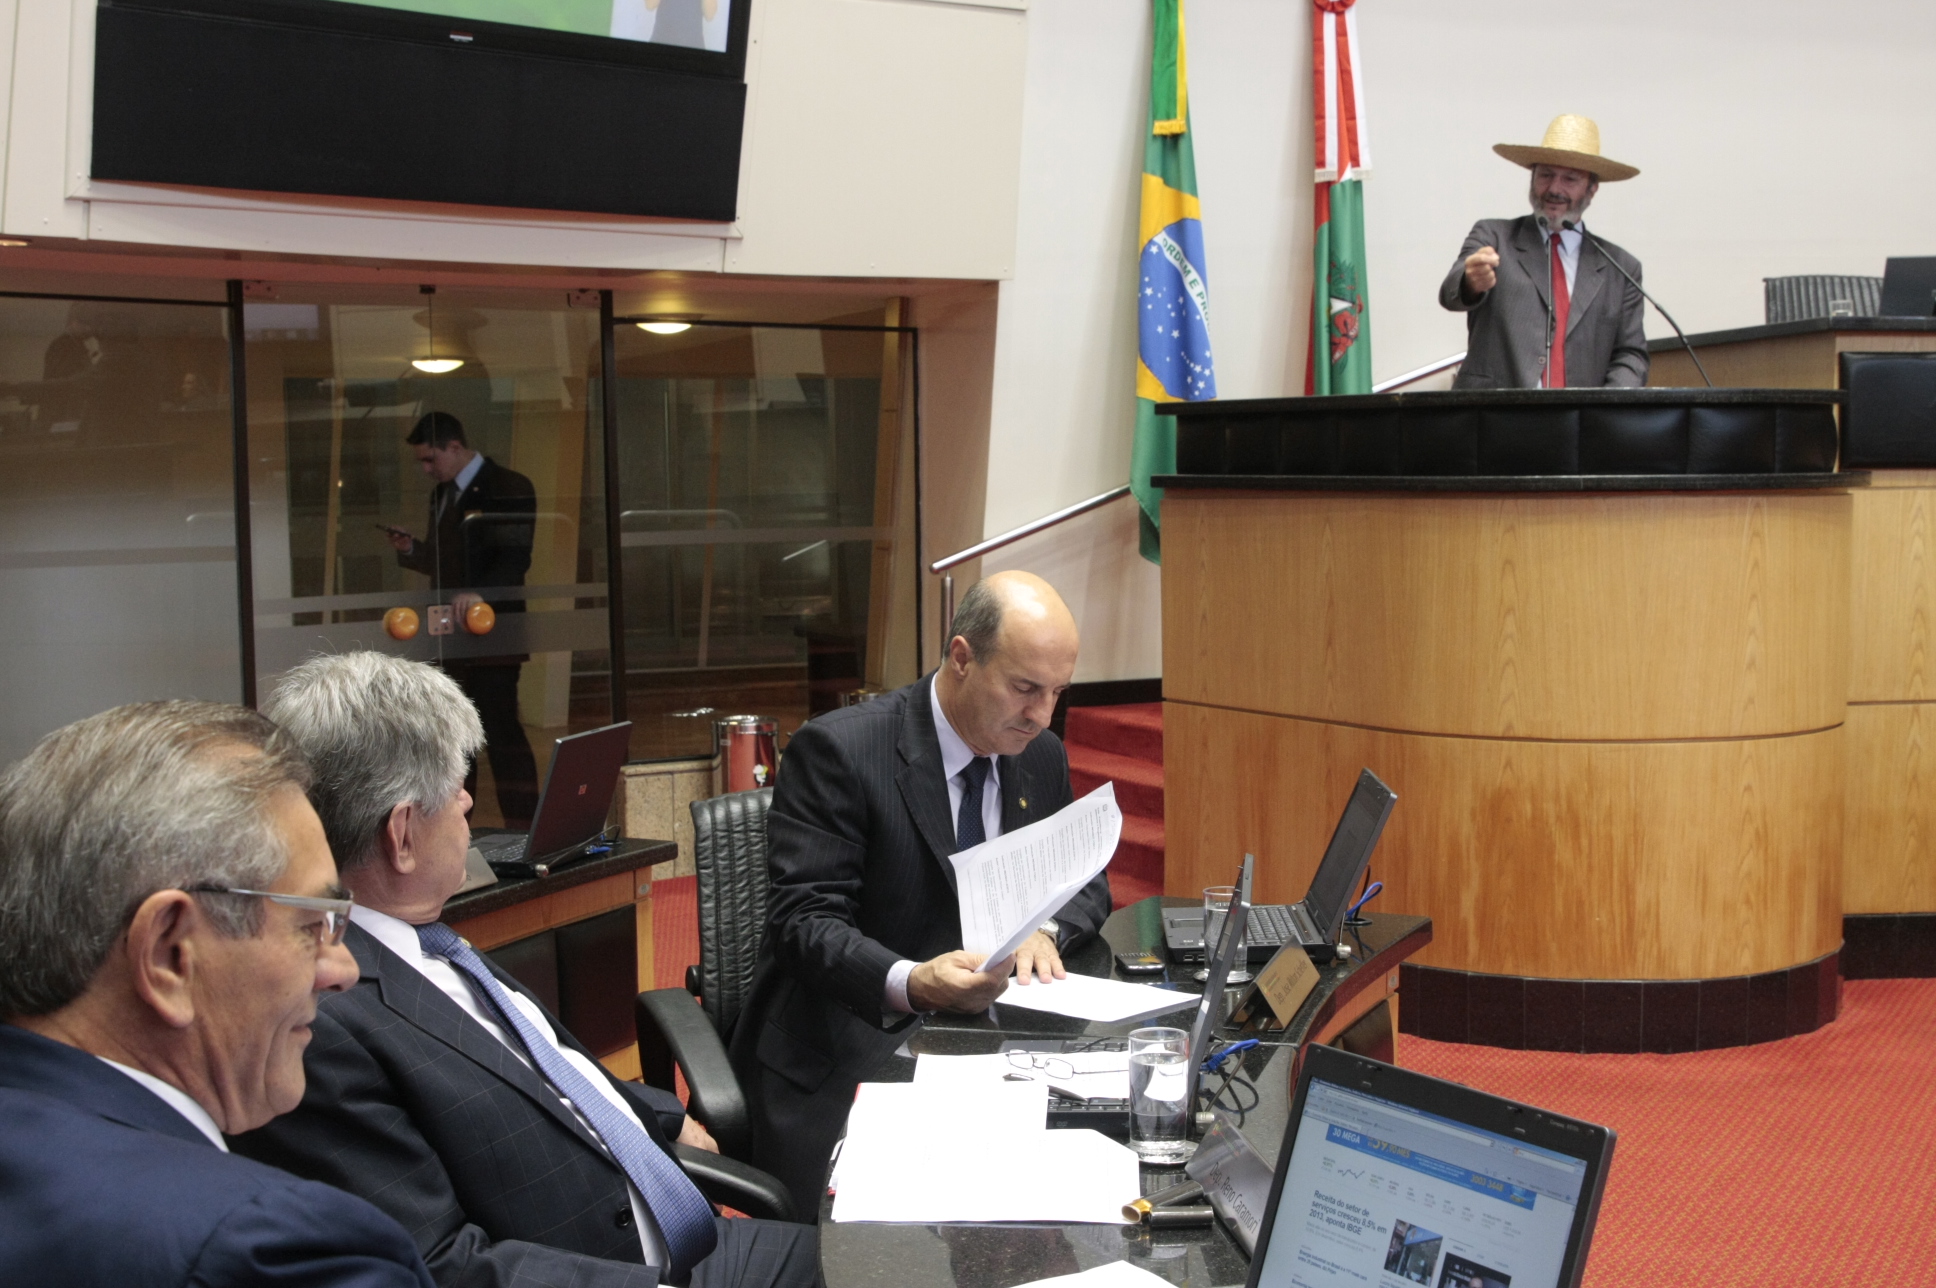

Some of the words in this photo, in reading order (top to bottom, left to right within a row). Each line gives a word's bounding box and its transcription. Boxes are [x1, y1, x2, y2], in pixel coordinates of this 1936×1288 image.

[1162, 238, 1192, 278] ORDEM
[1189, 278, 1200, 290] E
[1332, 1127, 1342, 1138] 30
[1341, 1130, 1361, 1145] MEGA
[1209, 1161, 1222, 1186] Dep.
[1220, 1176, 1236, 1203] Reno
[1311, 1200, 1337, 1216] serviços
[1337, 1209, 1362, 1224] cresceu
[1361, 1218, 1377, 1231] 8,5%
[1376, 1225, 1388, 1235] em
[1313, 1190, 1337, 1206] Receita
[1336, 1199, 1346, 1209] do
[1345, 1203, 1362, 1214] setor
[1361, 1208, 1371, 1218] de
[1309, 1209, 1325, 1222] 2013,
[1325, 1215, 1346, 1230] aponta
[1346, 1222, 1363, 1236] IBGE
